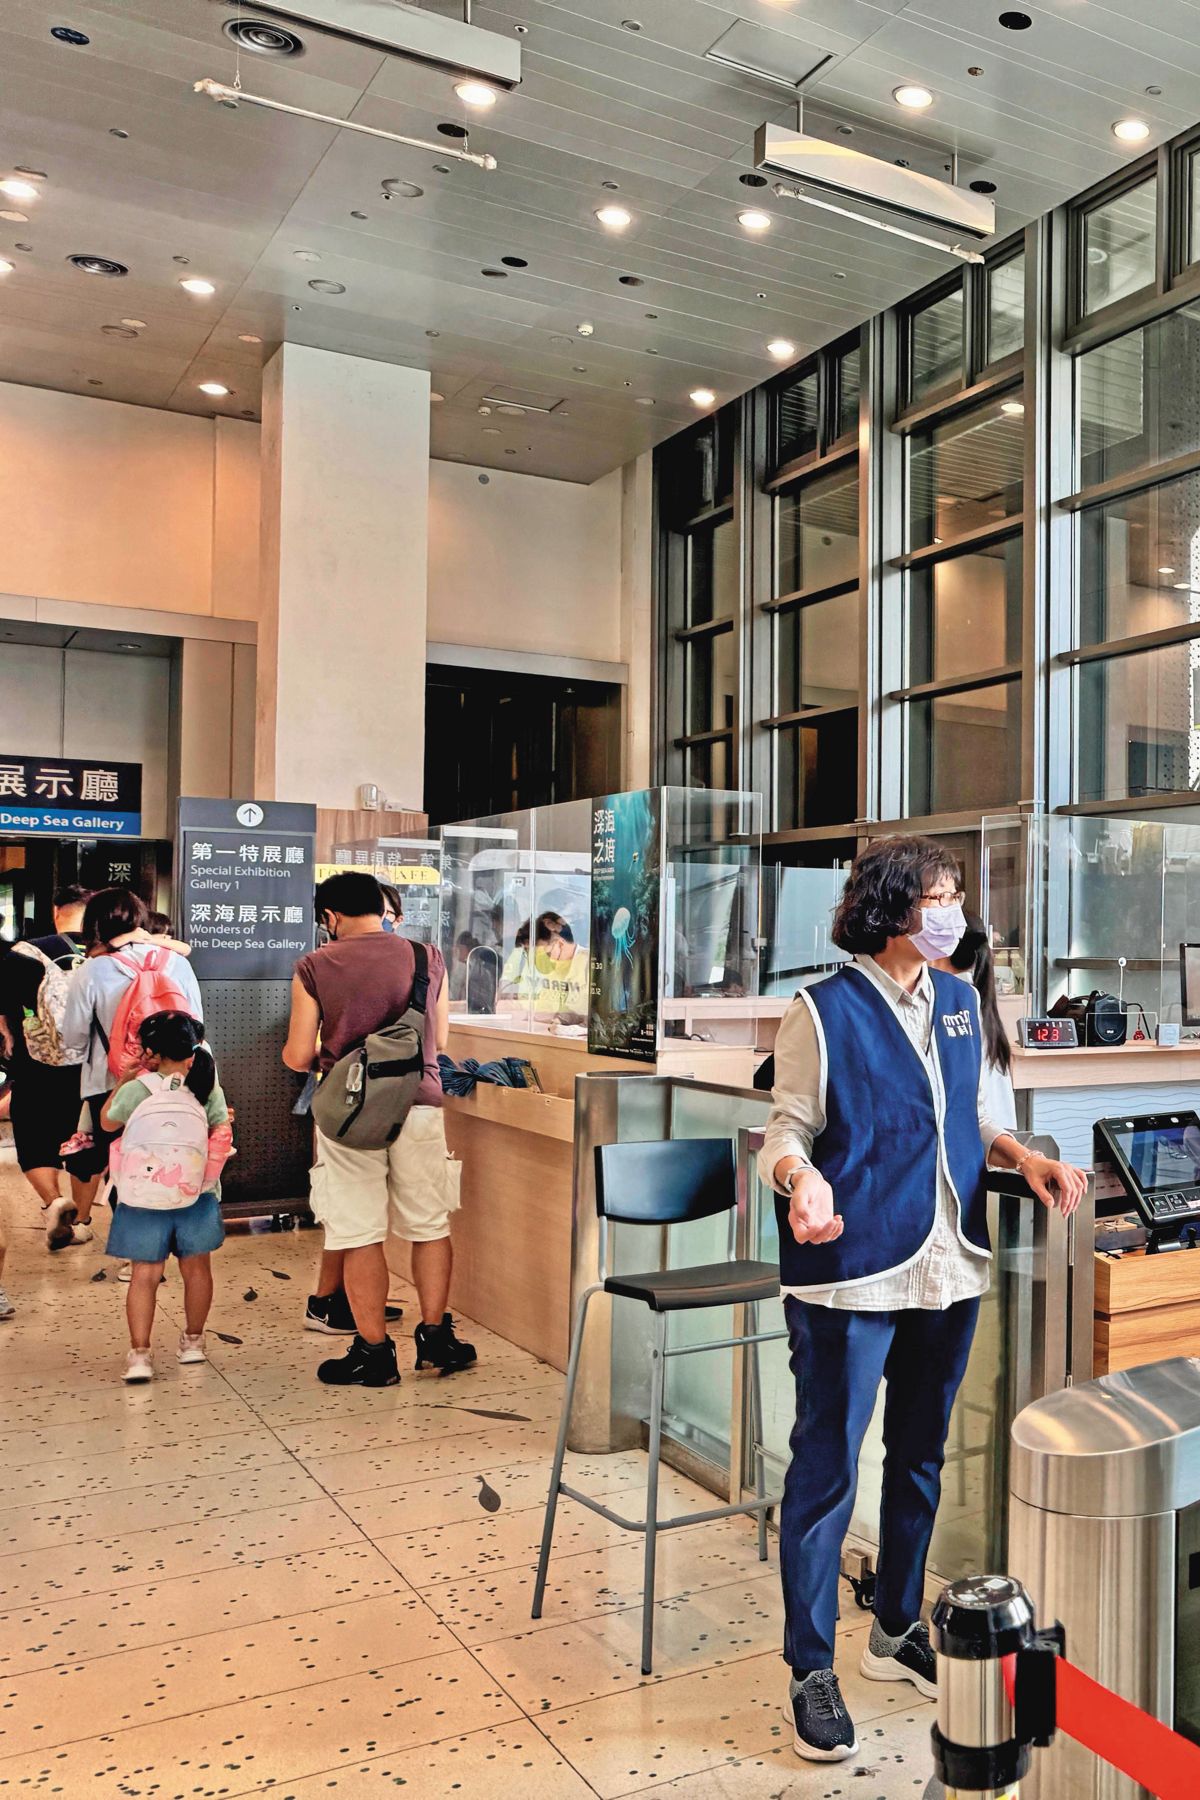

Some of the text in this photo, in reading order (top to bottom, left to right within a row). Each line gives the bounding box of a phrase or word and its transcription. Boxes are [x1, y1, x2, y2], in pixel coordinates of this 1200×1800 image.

[0, 764, 119, 802] 展示廳
[0, 813, 124, 832] Deep Sea Gallery
[191, 842, 305, 864] 第一特展廳
[190, 865, 291, 878] Special Exhibition
[190, 879, 240, 892] Gallery 1
[190, 903, 304, 924] 深海展示廳
[189, 924, 256, 935] Wonders of
[189, 938, 307, 951] the Deep Sea Gallery
